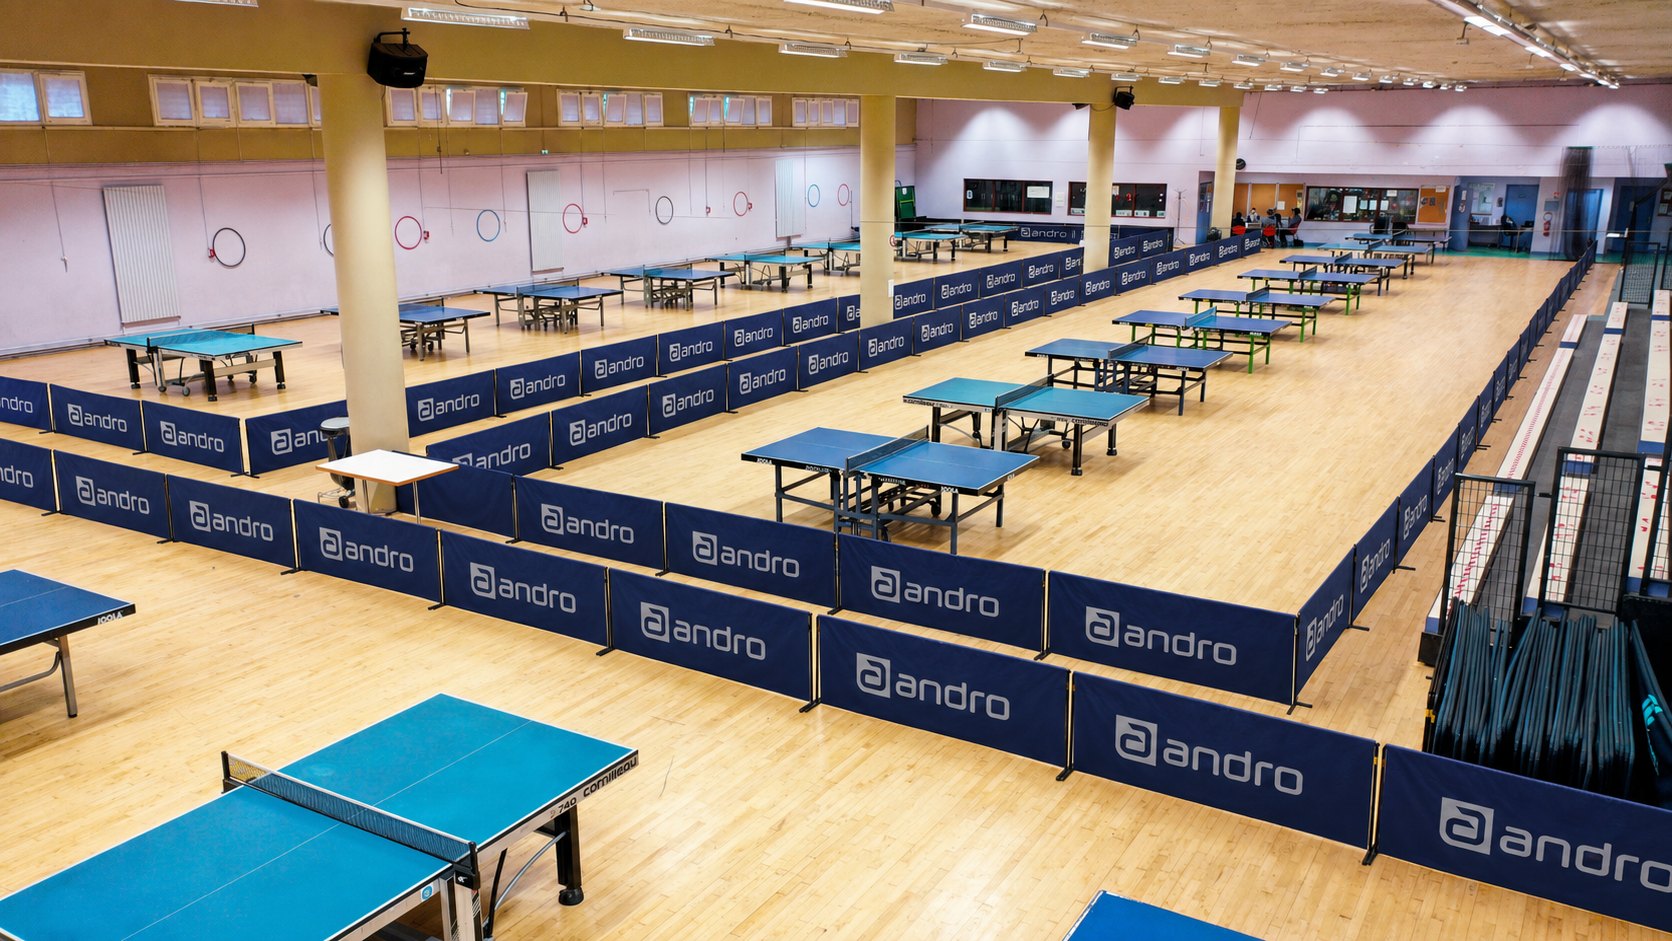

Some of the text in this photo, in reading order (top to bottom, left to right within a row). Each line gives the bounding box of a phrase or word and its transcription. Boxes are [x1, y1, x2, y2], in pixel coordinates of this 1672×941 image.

[1035, 264, 1053, 275] andro
[1128, 271, 1146, 282] andro
[994, 274, 1015, 285] andro
[1092, 281, 1110, 292] andro
[949, 283, 972, 296] andro
[1058, 290, 1074, 302] andro
[903, 293, 926, 306] andro
[1019, 300, 1038, 313] andro
[803, 315, 828, 329] andro
[977, 311, 997, 324] andro
[745, 328, 773, 342] andro
[930, 323, 953, 337] andro
[682, 341, 712, 357] andro
[879, 336, 904, 352] andro
[609, 356, 644, 374] andro
[820, 352, 848, 369] andro
[526, 375, 565, 394] andro
[754, 369, 785, 388] andro
[0, 397, 33, 413] ndro
[436, 394, 479, 414] andro
[677, 389, 714, 410] andro
[84, 413, 127, 432] andro
[588, 414, 631, 438] andro
[178, 431, 224, 452] andro
[476, 443, 530, 469] andro
[97, 489, 149, 514] andro
[213, 513, 273, 541] andro
[567, 517, 634, 543] andro
[346, 541, 413, 572] andro
[721, 546, 799, 577] andro
[1368, 538, 1390, 579] andro
[499, 578, 576, 613] andro
[904, 582, 999, 617] andro
[97, 611, 123, 625] JOOLA
[1316, 594, 1344, 644] andro
[676, 620, 765, 660] andro
[1124, 625, 1236, 665] andro
[896, 673, 1009, 720] andro
[1164, 739, 1303, 795] andro
[558, 755, 637, 814] 740 cornilleau
[1500, 826, 1672, 892] andro
